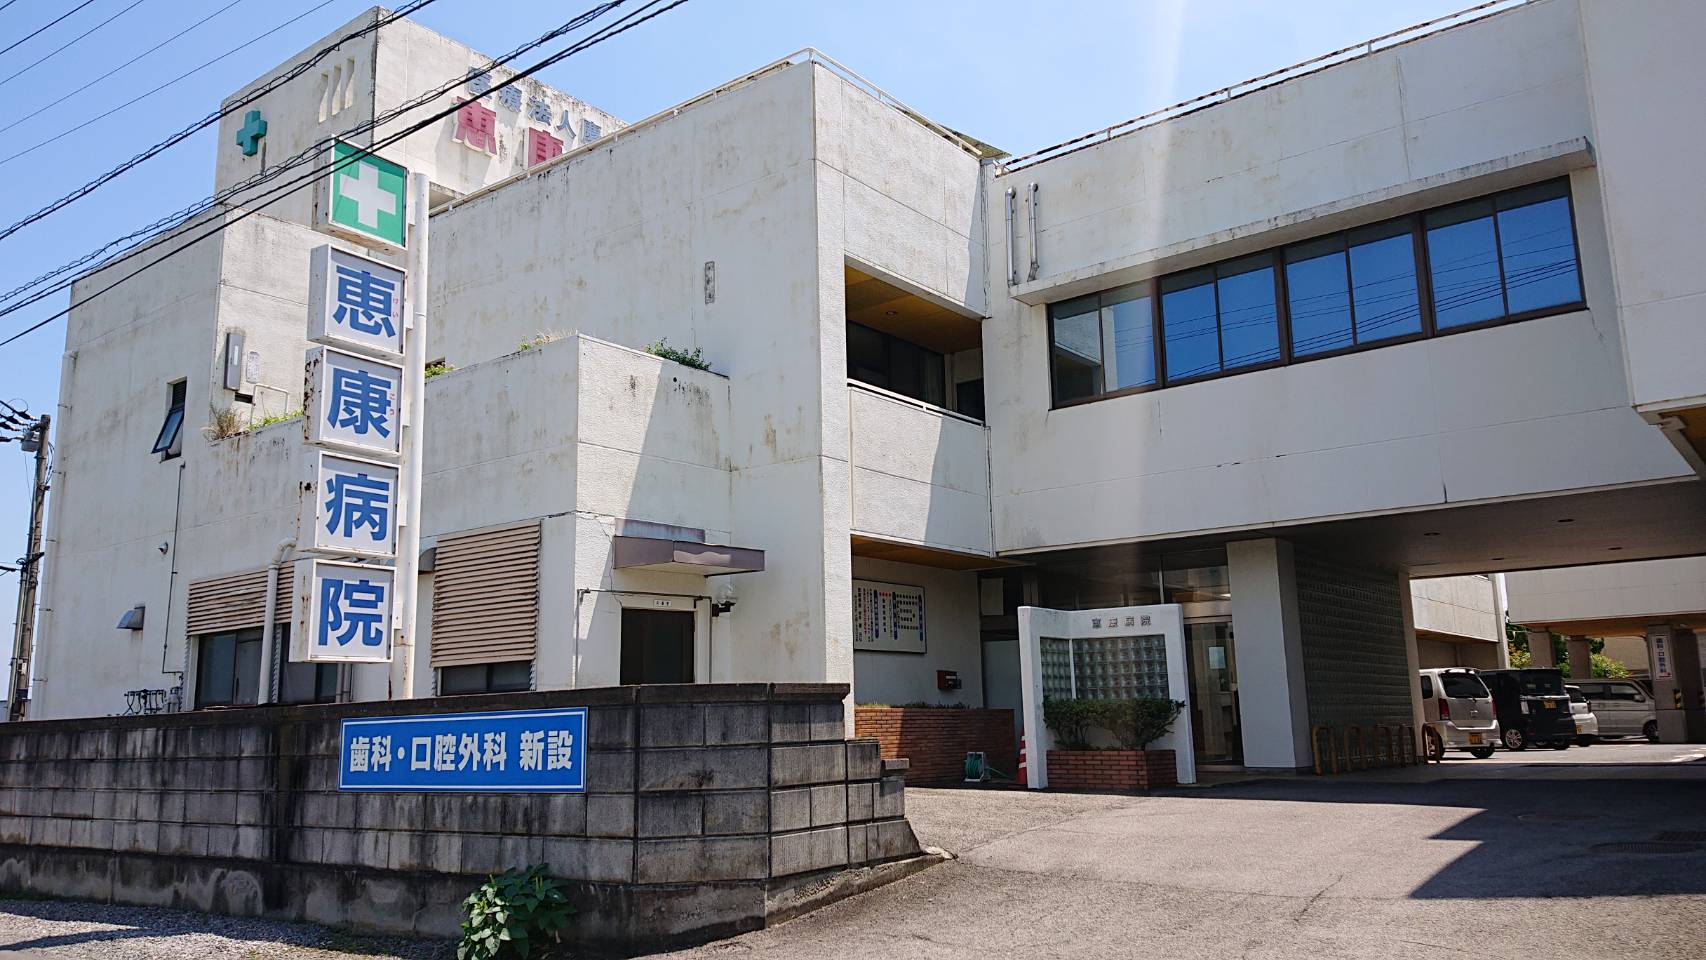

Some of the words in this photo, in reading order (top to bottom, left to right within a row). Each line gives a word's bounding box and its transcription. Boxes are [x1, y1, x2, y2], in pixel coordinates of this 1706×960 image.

[318, 265, 396, 647] 恵康病院
[350, 731, 507, 773] 歯科・口腔外科
[519, 729, 573, 771] 新設
